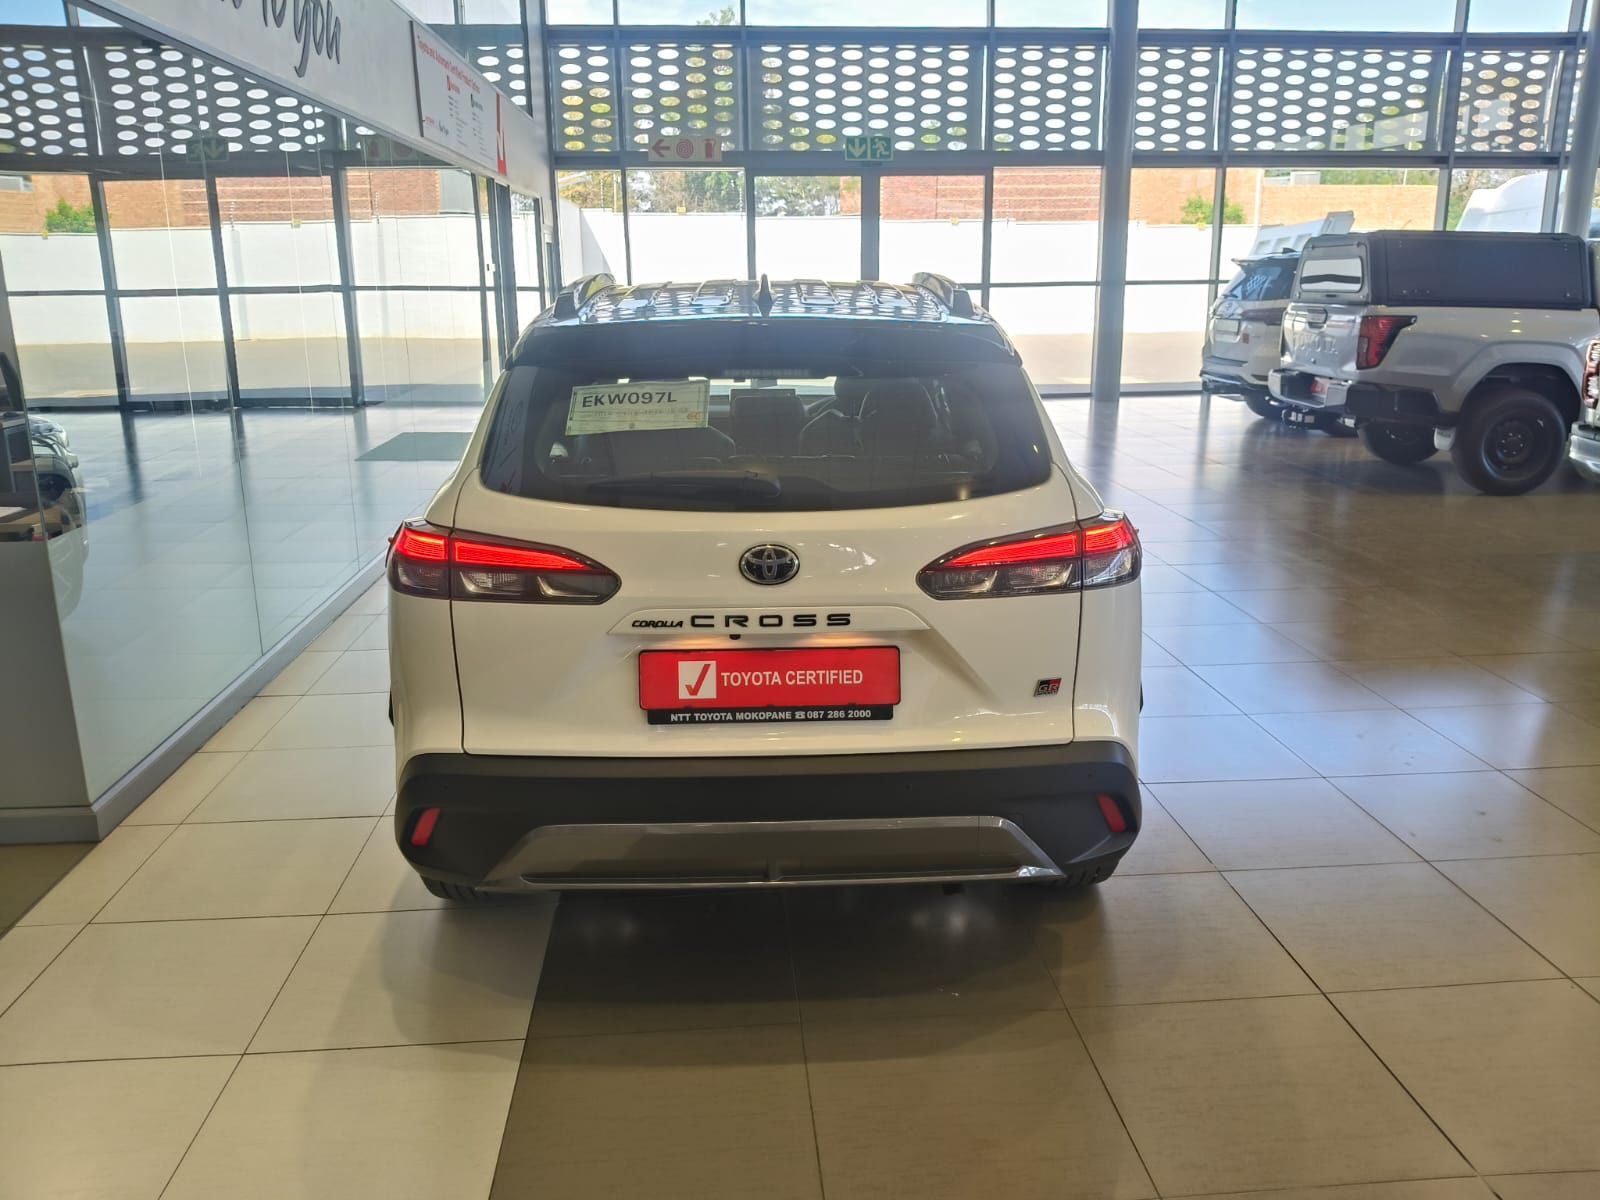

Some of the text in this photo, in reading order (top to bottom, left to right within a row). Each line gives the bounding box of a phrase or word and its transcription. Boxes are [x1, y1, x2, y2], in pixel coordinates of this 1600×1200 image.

[293, 0, 341, 78] you
[582, 391, 678, 408] EKW097L
[632, 613, 851, 629] COROLLA CROSS
[720, 669, 863, 687] TOYOTA CERTIFIED
[670, 709, 872, 722] NTT TOYOTA MOKOPANE 087 286 2000
